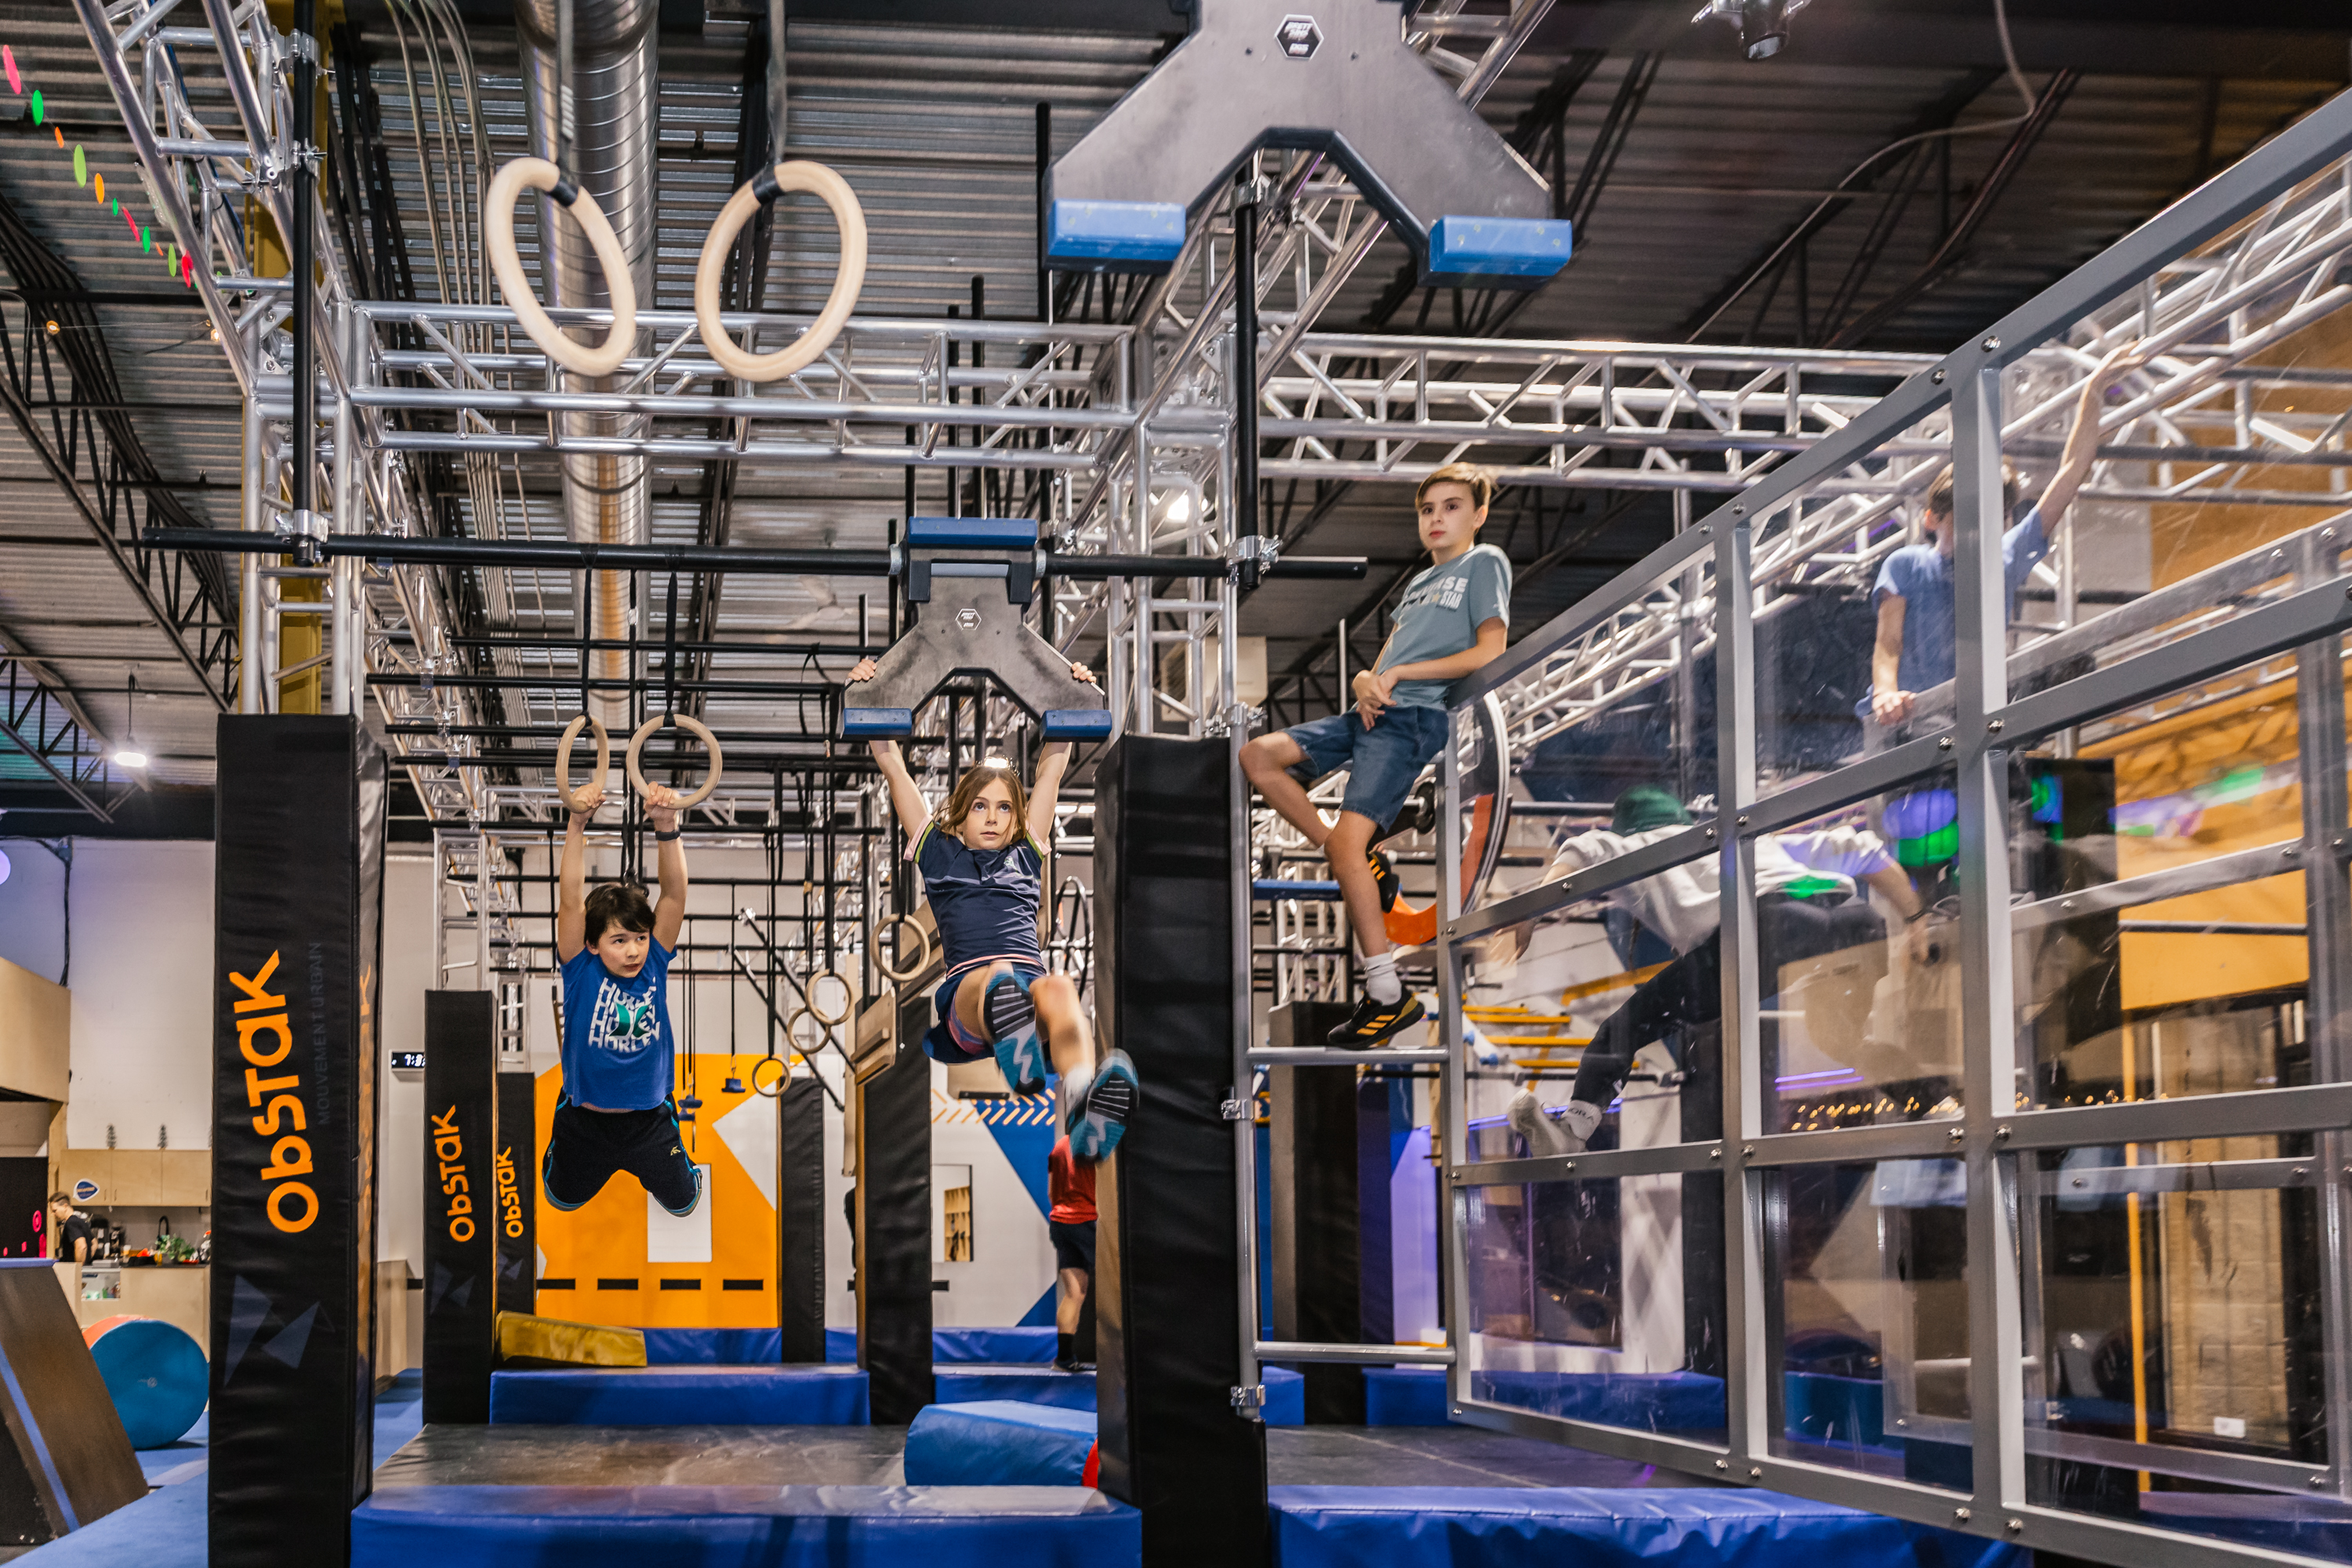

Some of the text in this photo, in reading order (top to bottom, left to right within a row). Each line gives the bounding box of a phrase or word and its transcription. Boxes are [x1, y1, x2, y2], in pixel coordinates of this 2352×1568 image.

[1439, 590, 1462, 609] STAR
[309, 942, 330, 1125] MOUVEMENT URBAIN
